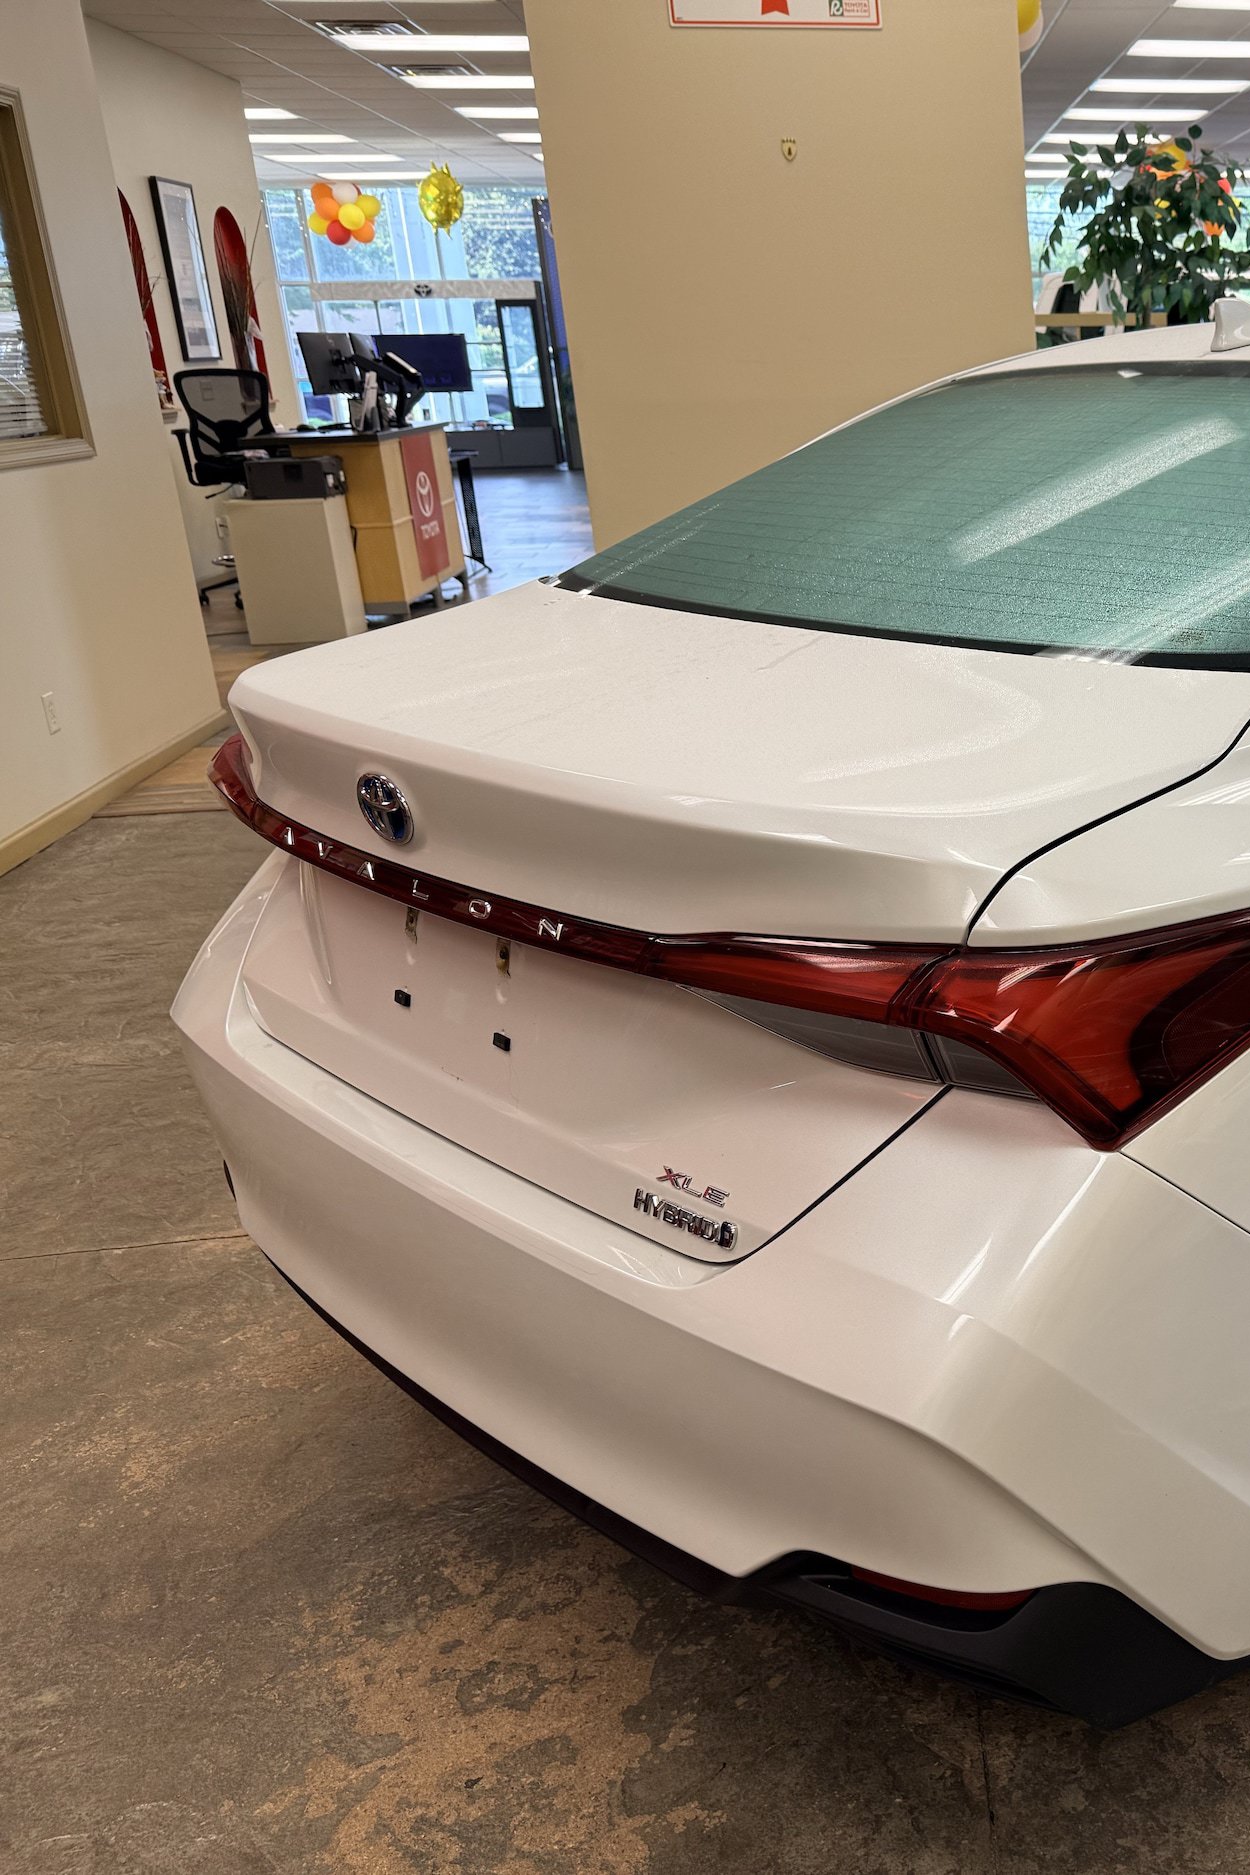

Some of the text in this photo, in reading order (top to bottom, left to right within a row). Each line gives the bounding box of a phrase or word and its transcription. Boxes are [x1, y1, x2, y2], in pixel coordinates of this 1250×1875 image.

[279, 826, 565, 942] AVALON
[655, 1164, 731, 1208] XLE
[632, 1187, 721, 1243] HYBRID
